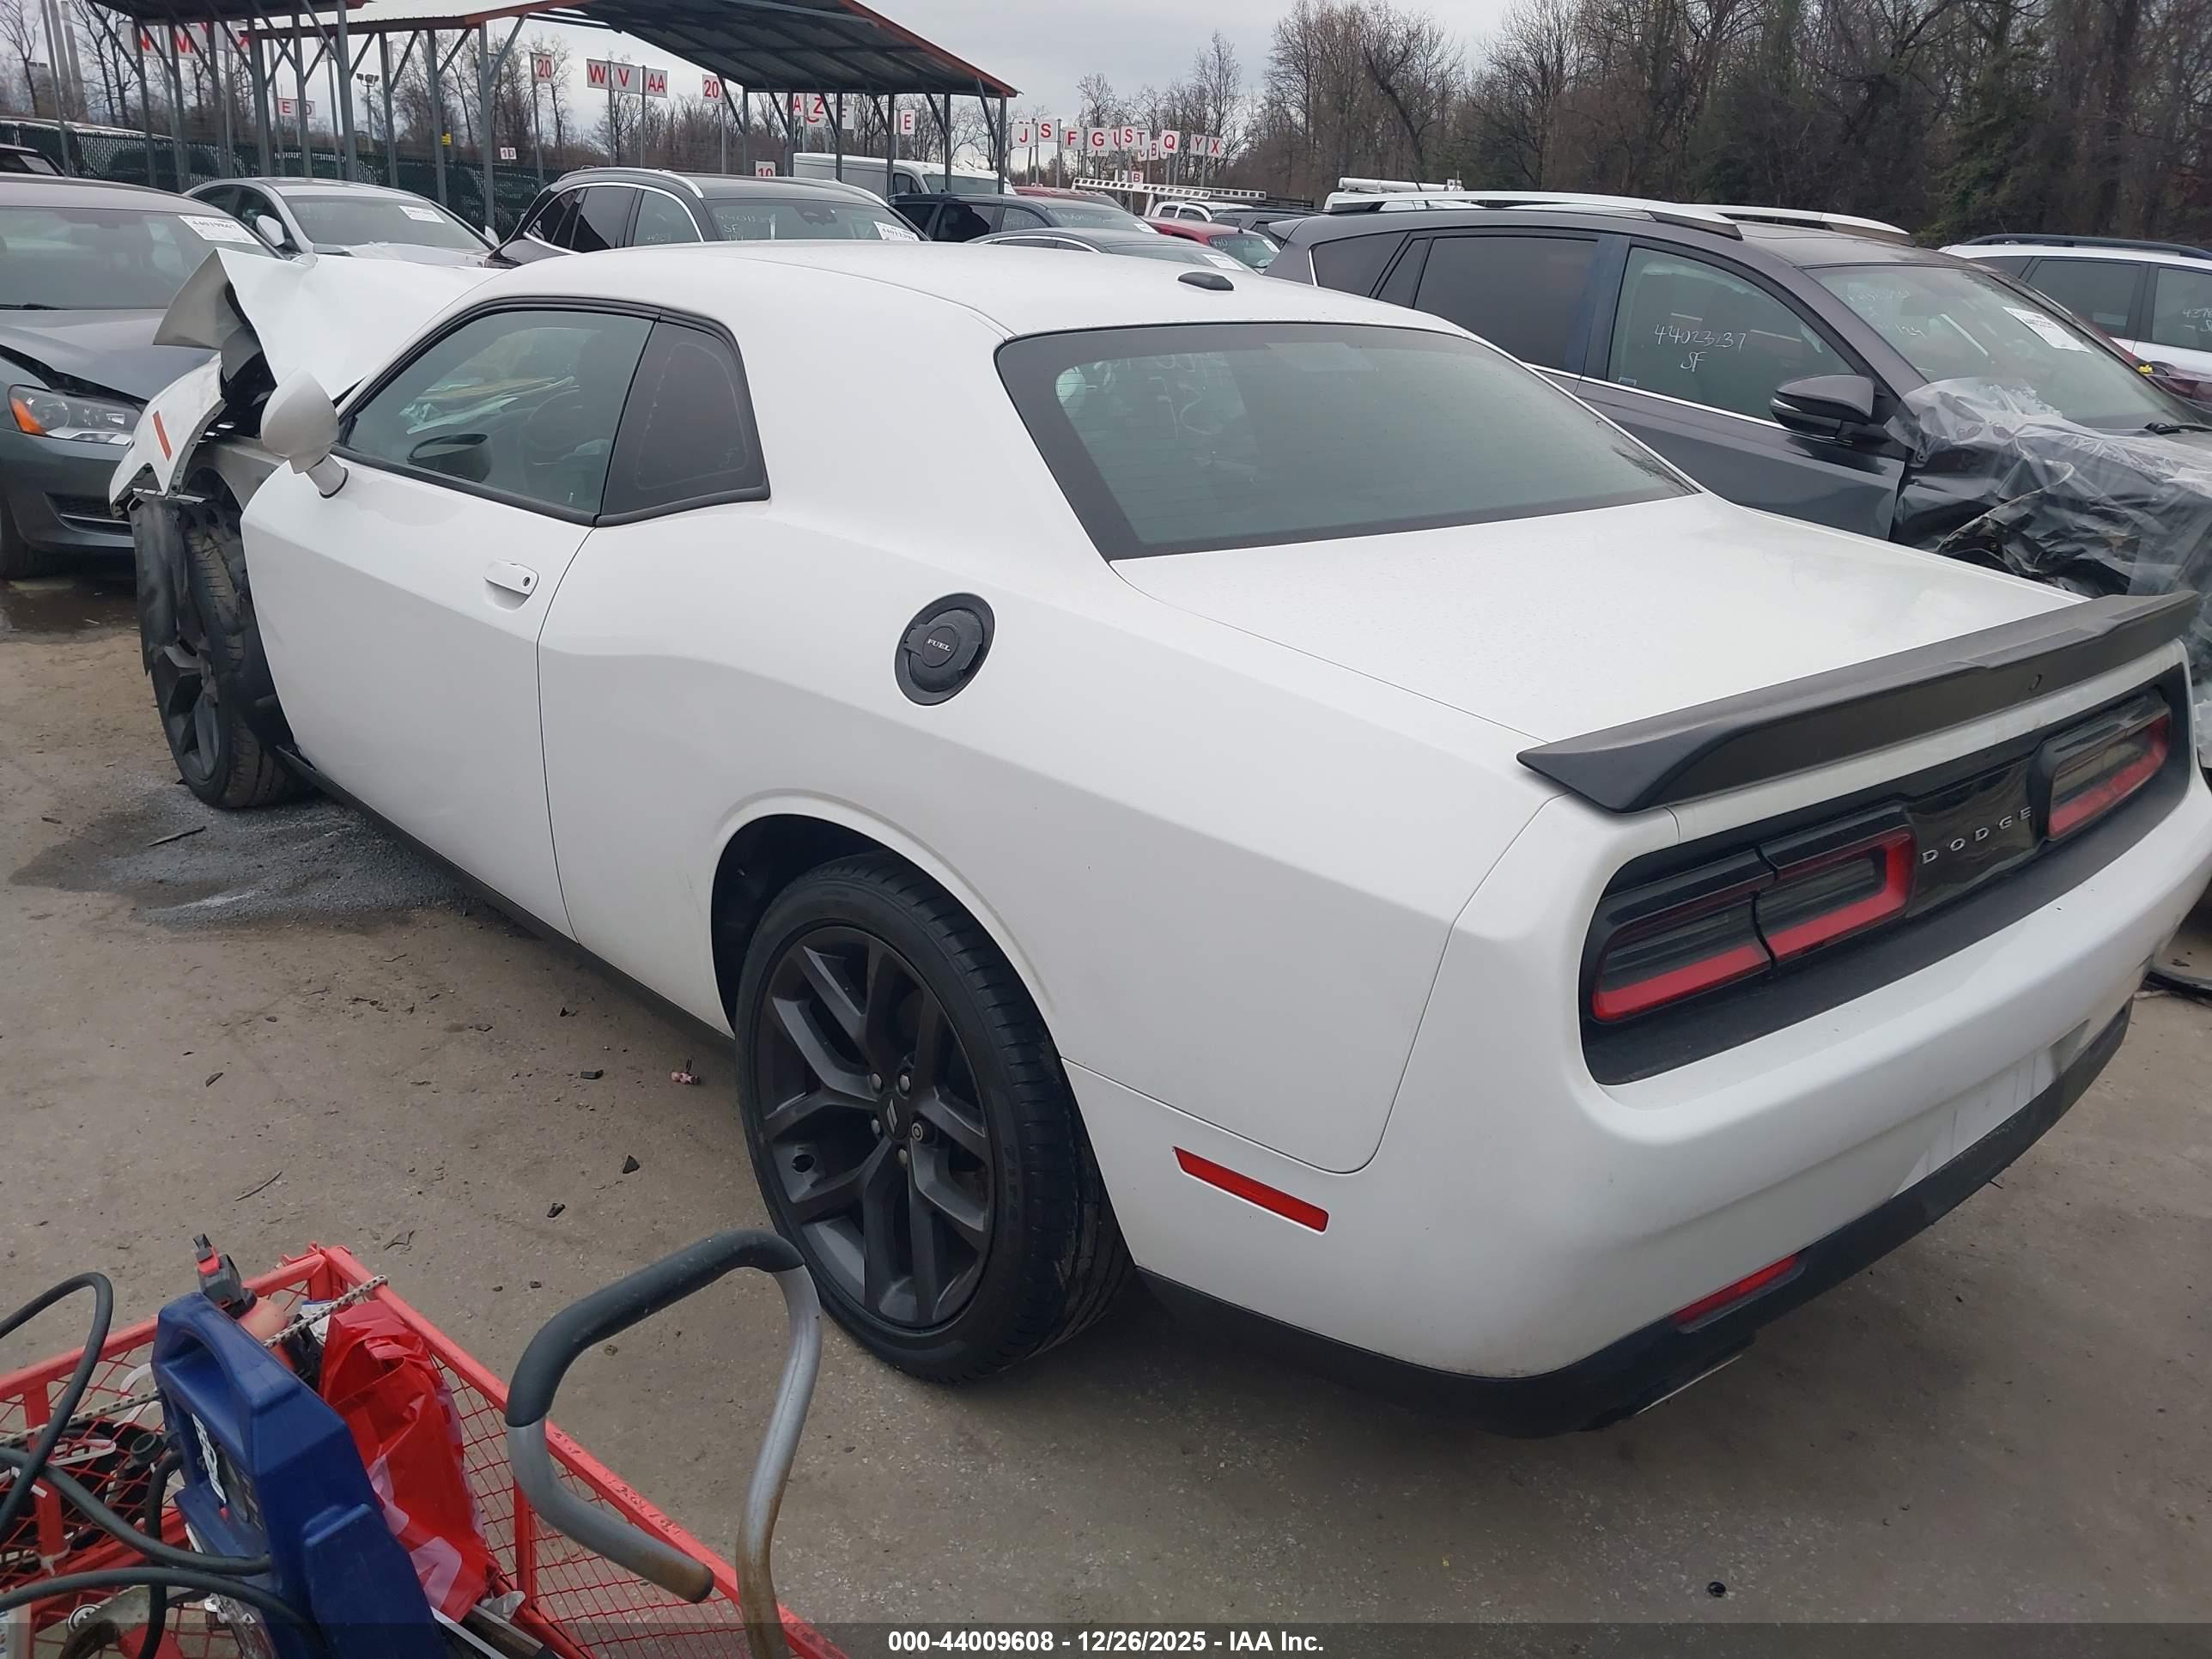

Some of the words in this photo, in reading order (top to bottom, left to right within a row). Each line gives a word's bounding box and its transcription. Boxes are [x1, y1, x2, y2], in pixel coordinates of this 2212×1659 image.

[538, 59, 550, 78] 20
[589, 64, 606, 84] W
[618, 68, 629, 87] V
[647, 73, 665, 93] AA
[703, 80, 719, 99] 20
[282, 101, 291, 113] E
[813, 97, 824, 114] Z
[903, 113, 912, 131] E
[1018, 128, 1028, 143] J
[1040, 123, 1052, 138] S
[1067, 131, 1078, 145] F
[1124, 128, 1133, 143] S
[1091, 131, 1104, 147] G
[1136, 131, 1146, 146] T
[1164, 134, 1176, 150] Q
[1194, 137, 1203, 151] Y
[1151, 143, 1157, 156] B
[1212, 139, 1220, 154] X
[1133, 173, 1141, 183] B
[1680, 351, 1707, 372] SF
[927, 638, 951, 652] FUEL
[1922, 806, 2032, 865] DODGE
